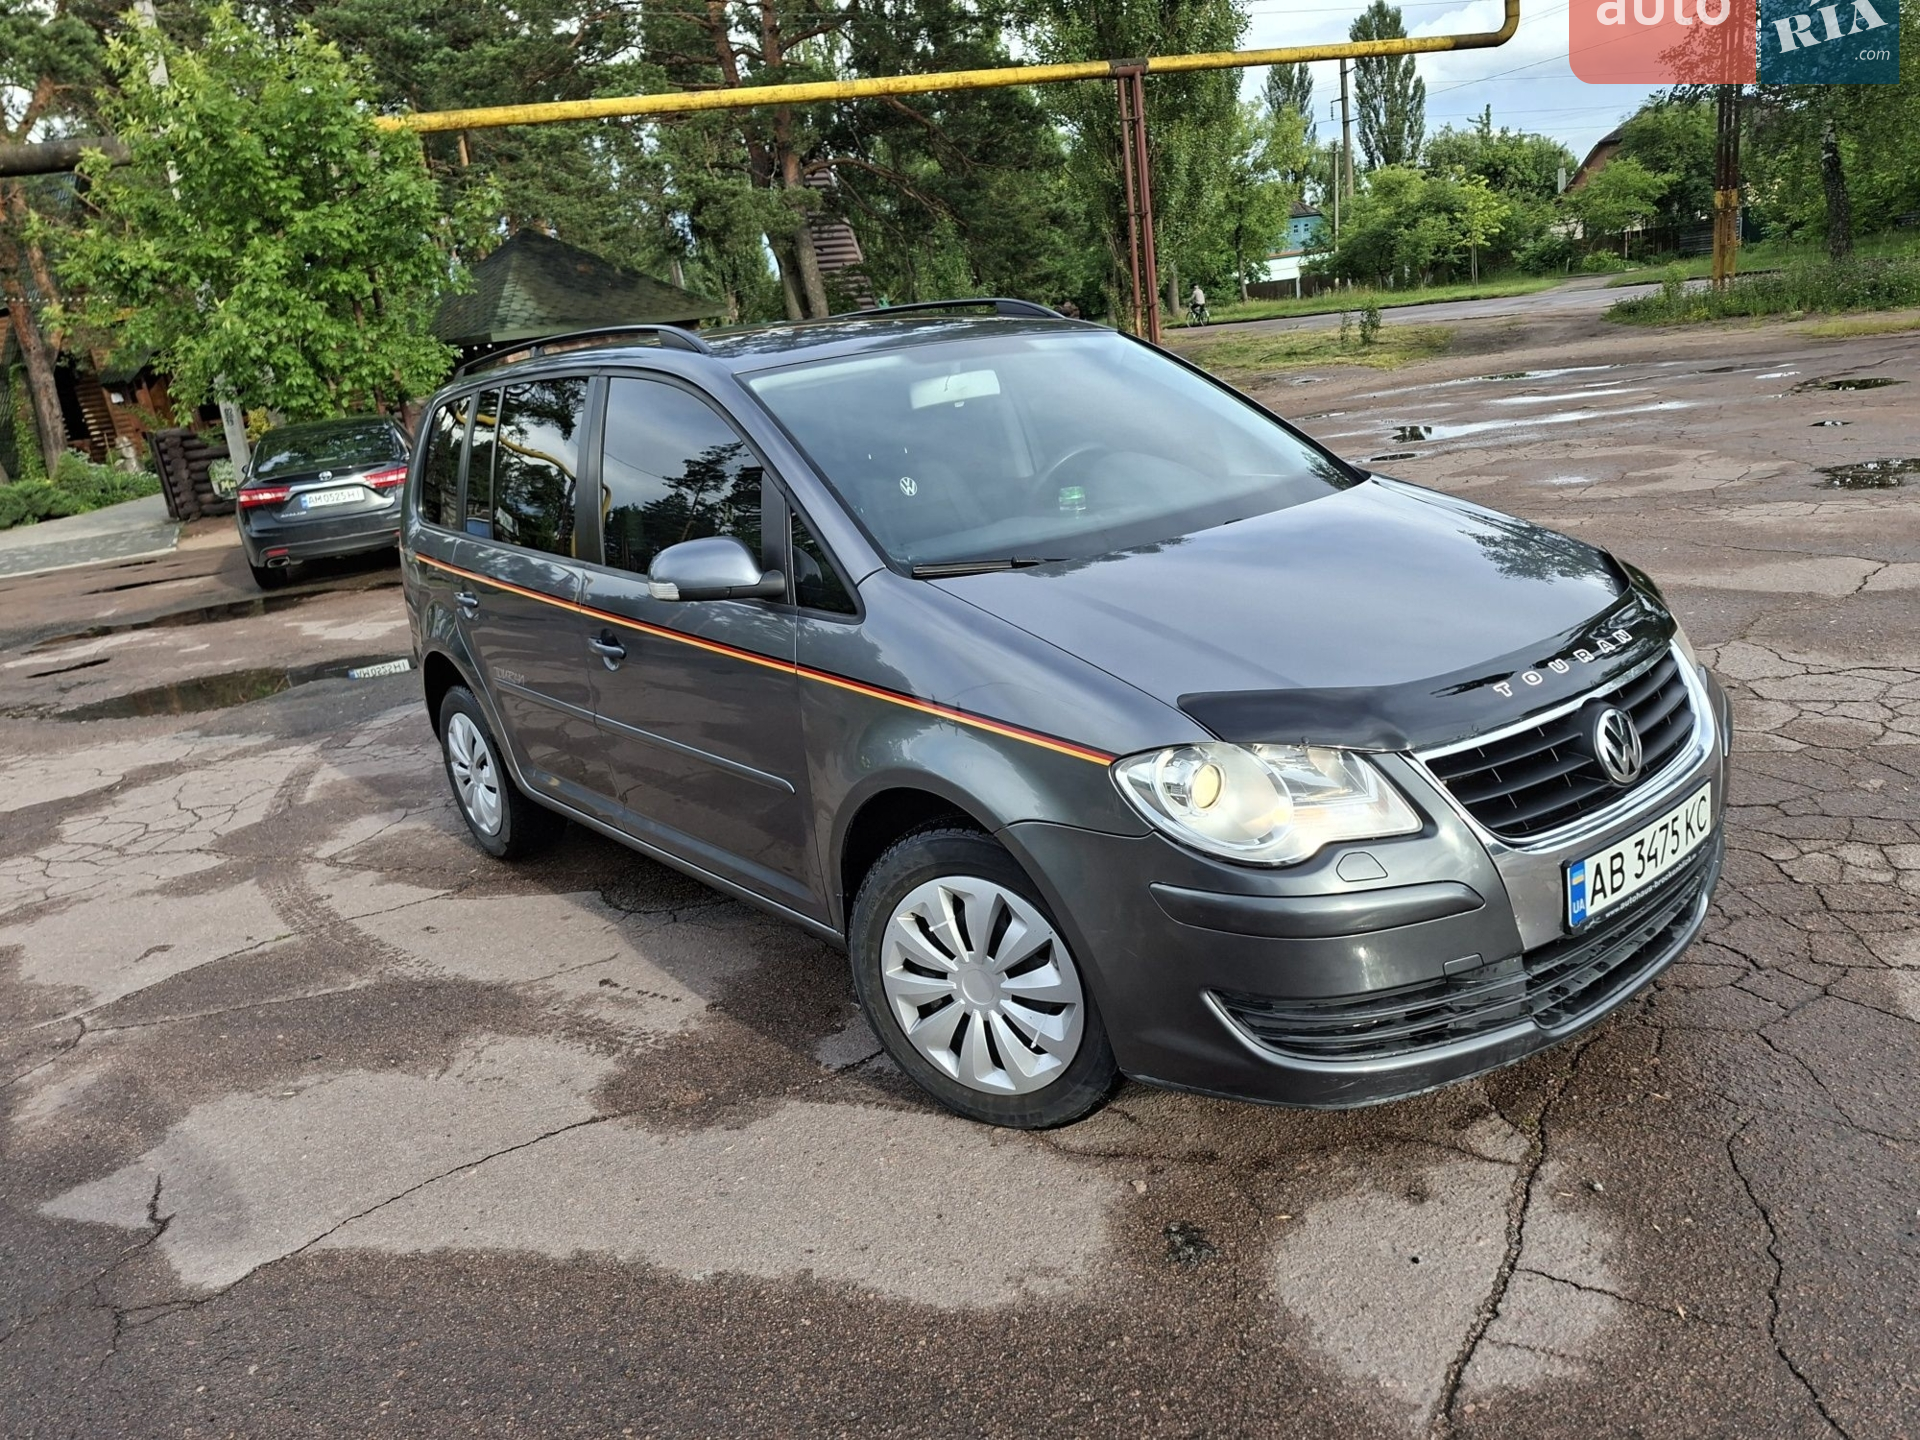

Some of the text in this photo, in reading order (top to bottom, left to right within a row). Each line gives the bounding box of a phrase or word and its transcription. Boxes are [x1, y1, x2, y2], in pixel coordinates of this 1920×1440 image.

[1493, 629, 1633, 697] TOURAN
[1589, 851, 1626, 907] AB
[1634, 814, 1680, 880] 3475
[1572, 897, 1587, 915] UA
